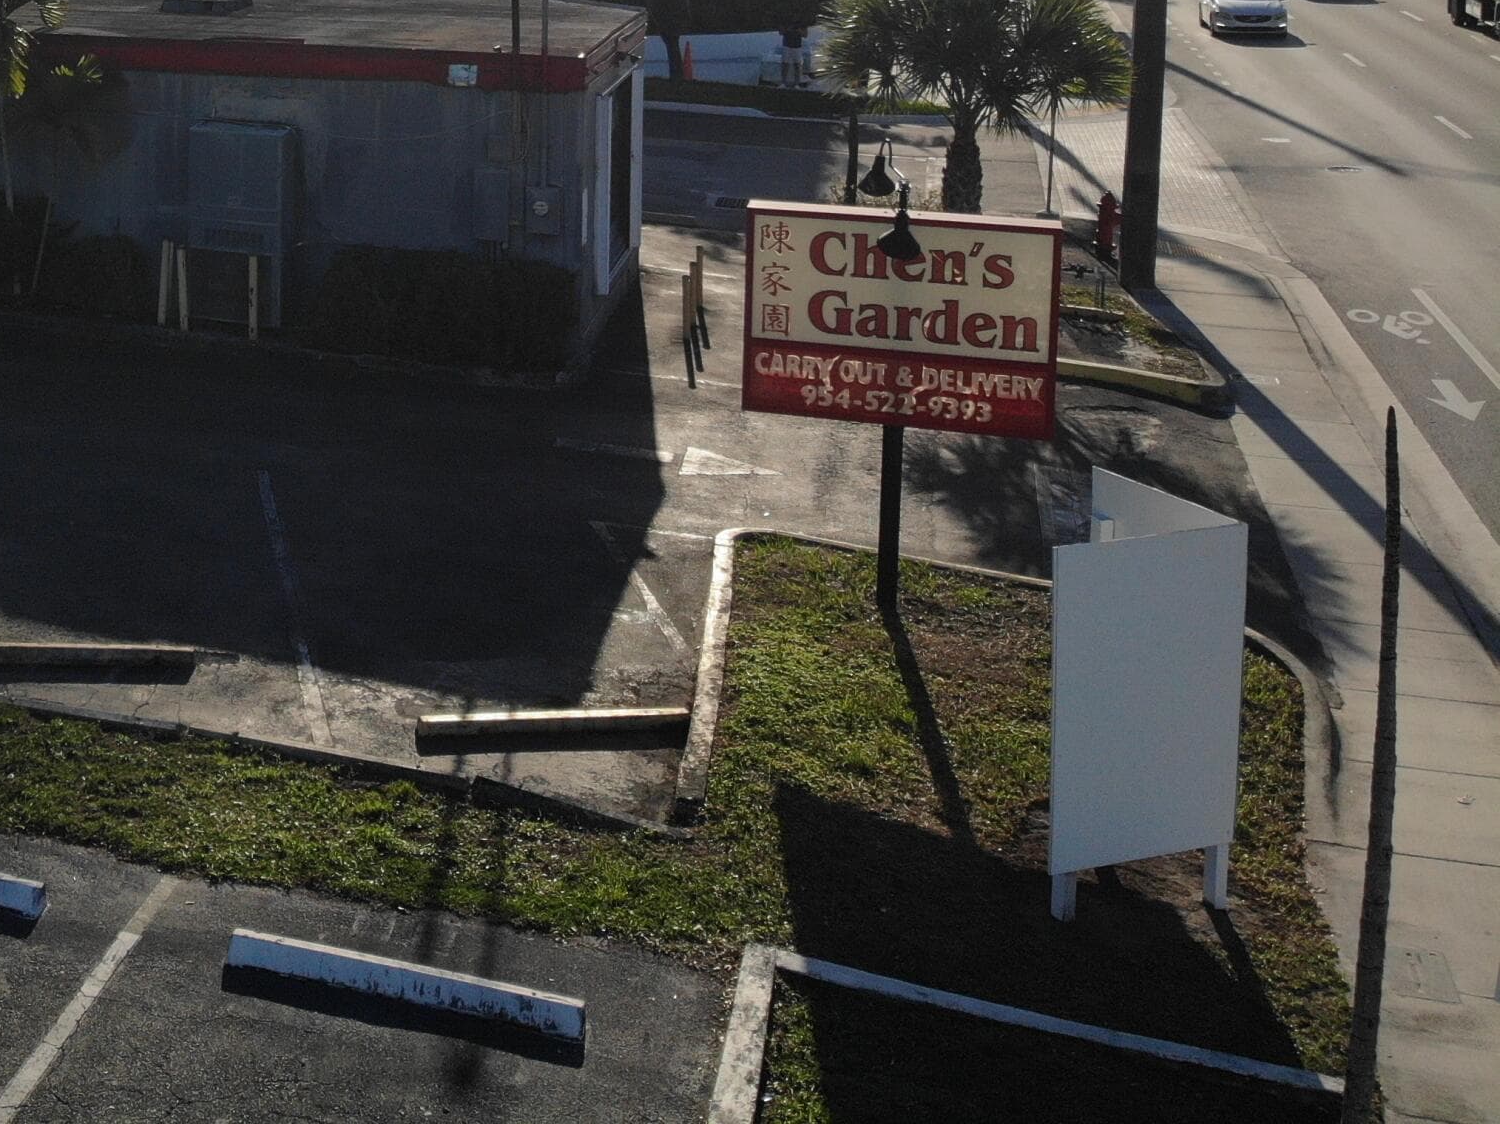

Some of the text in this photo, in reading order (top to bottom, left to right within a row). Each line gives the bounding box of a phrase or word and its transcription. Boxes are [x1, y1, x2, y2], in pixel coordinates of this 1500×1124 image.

[759, 221, 794, 336] 陳家園
[809, 231, 1014, 289] Chen's
[807, 290, 1039, 352] Garden
[754, 353, 1043, 400] CARRY OUT & DELIVERY
[801, 386, 992, 422] 954-522-9393
